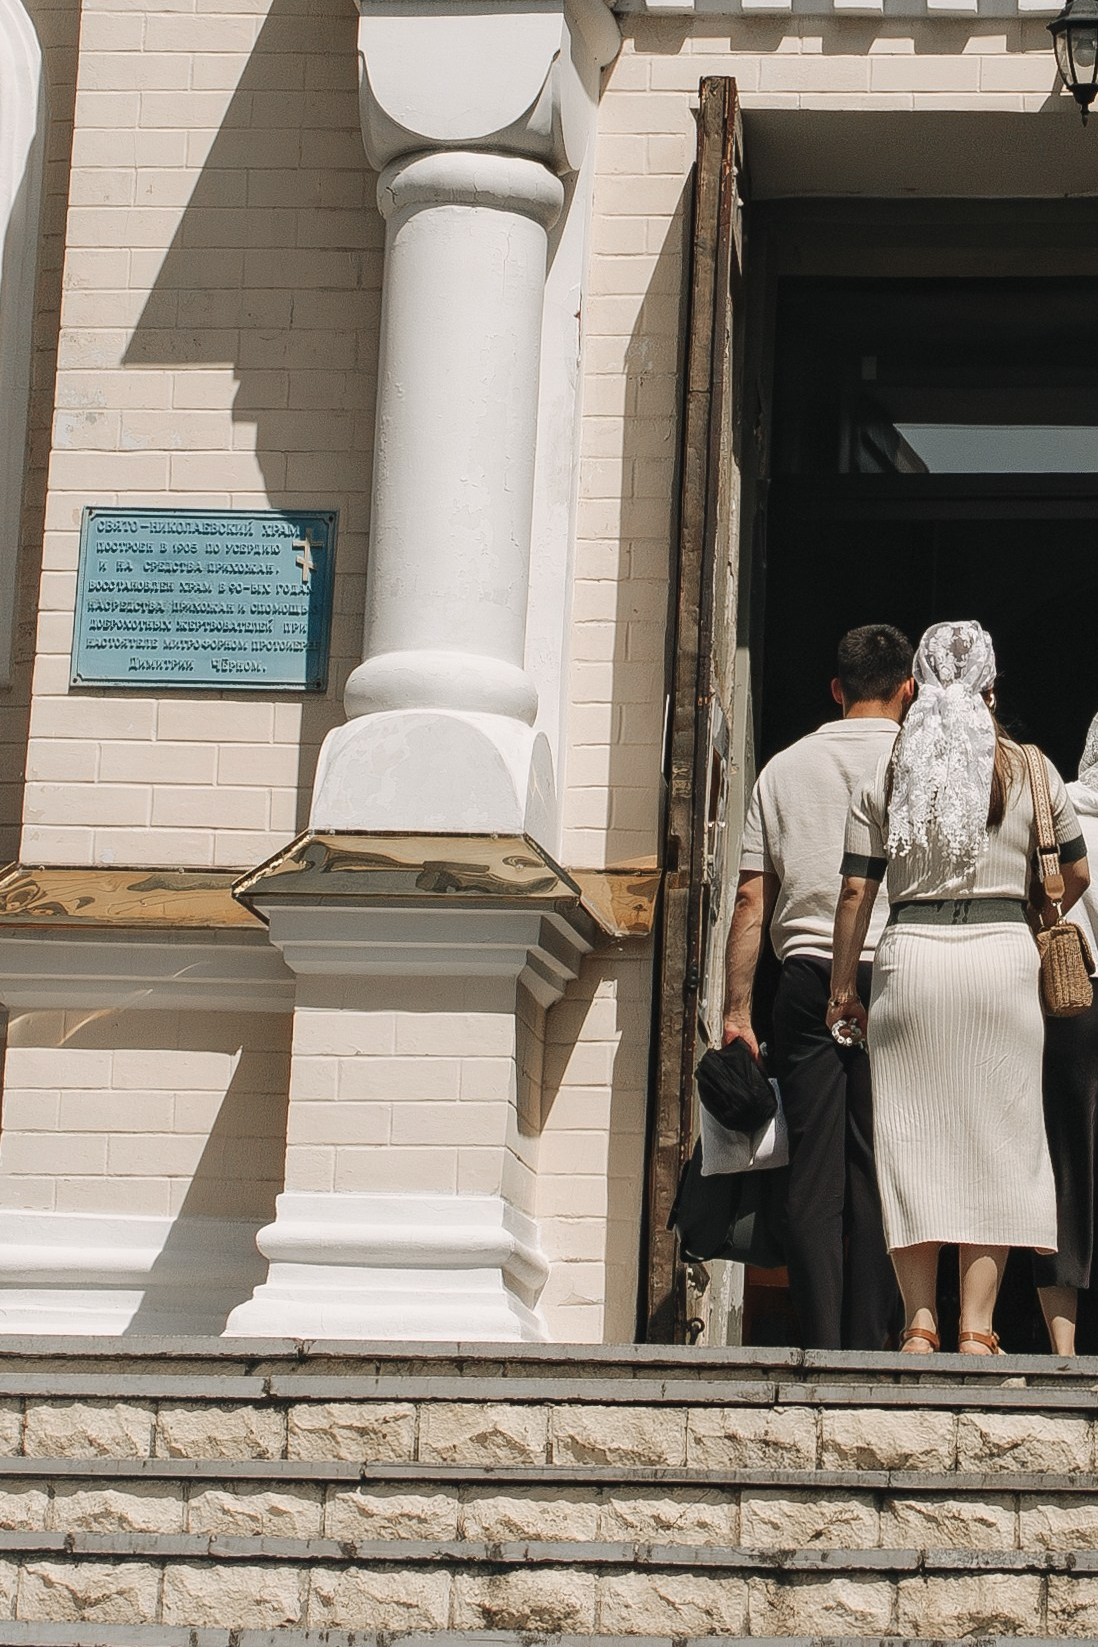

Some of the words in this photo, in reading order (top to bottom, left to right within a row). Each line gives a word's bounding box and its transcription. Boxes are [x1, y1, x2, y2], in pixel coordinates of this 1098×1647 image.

[261, 523, 301, 539] ХРАМ
[96, 542, 154, 554] ПОСТРОЕН
[159, 543, 168, 554] В
[172, 543, 199, 555] 1905
[205, 543, 220, 555] ПО
[225, 543, 281, 556] УСЕРДИЮ
[98, 560, 108, 572] И
[116, 560, 133, 573] НА
[143, 561, 203, 574] СРЕДСТВА
[88, 580, 174, 593] ВОССТАНОВЛЕН
[179, 581, 213, 594] ХРАМ
[217, 583, 225, 595] В
[171, 601, 234, 615] ПРИХОЖАН
[237, 603, 246, 615] И
[89, 619, 172, 632] ДОБРОХОТНЫХ
[175, 618, 274, 633] ЖЕРТВОВАТЕЛЕЙ
[283, 622, 308, 634] ПРИ
[85, 637, 159, 650] НАСТОЯТЕЛЕ
[162, 638, 248, 651] МИТРОФОРНОМ
